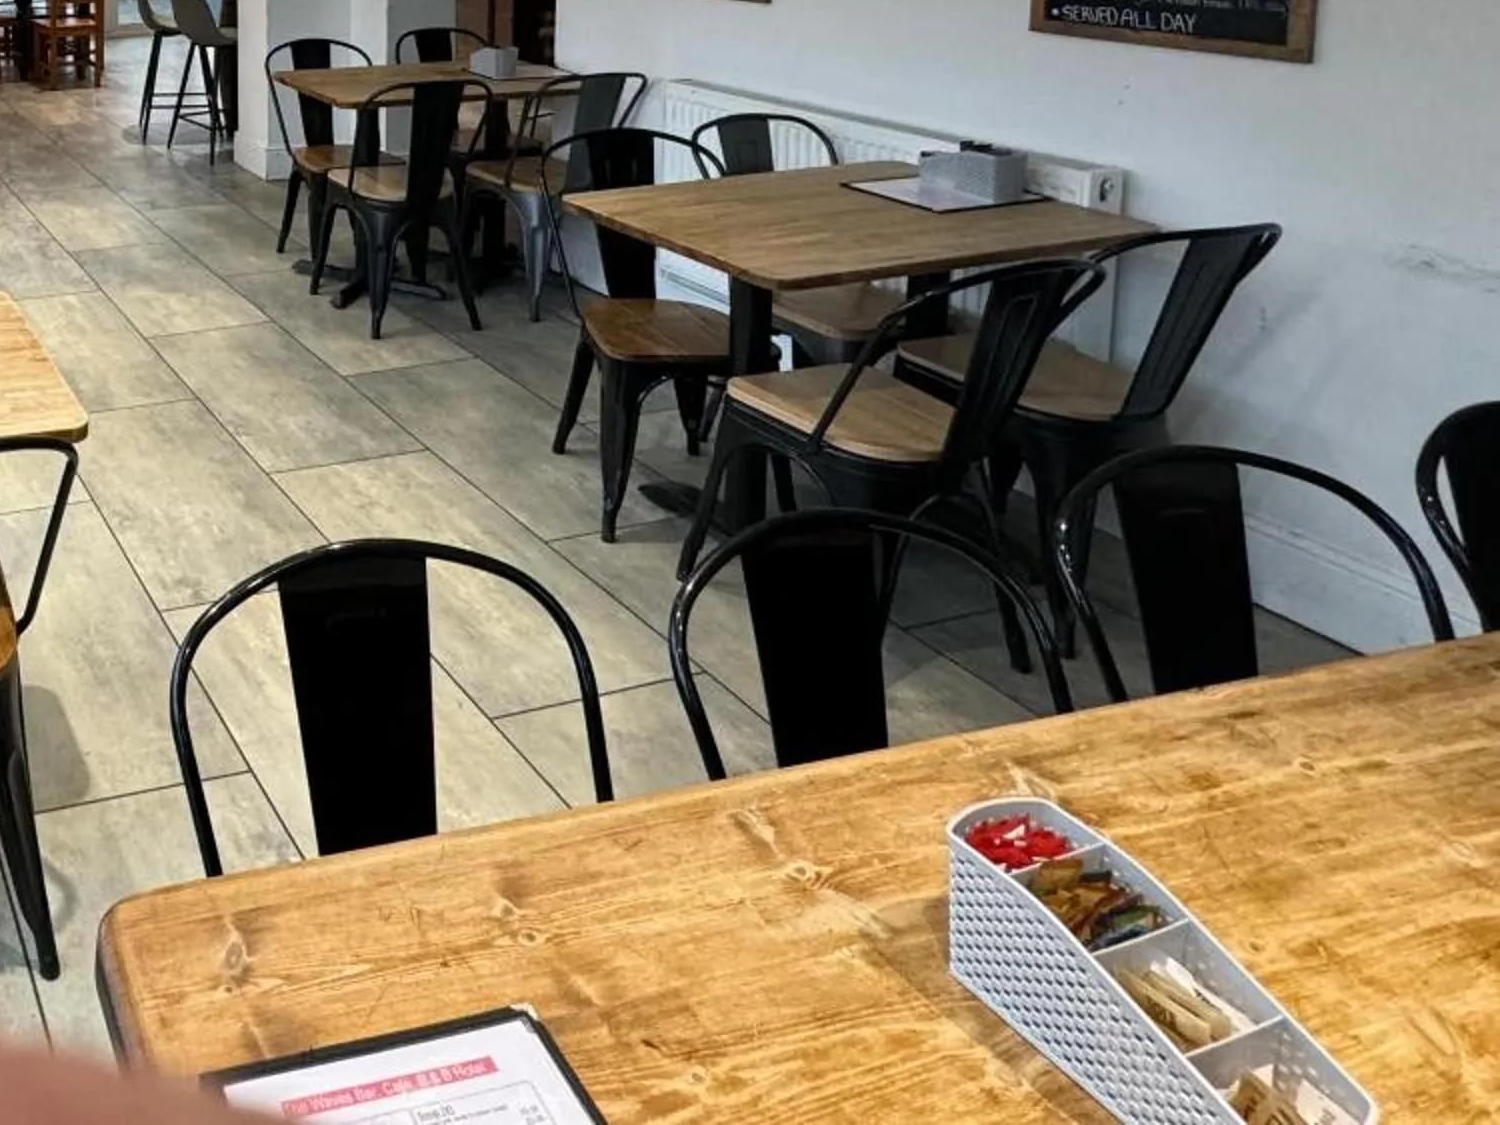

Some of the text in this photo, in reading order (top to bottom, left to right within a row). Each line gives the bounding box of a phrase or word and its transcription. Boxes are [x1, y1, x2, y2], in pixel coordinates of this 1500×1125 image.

[1061, 4, 1198, 34] SERVED ALL DAY
